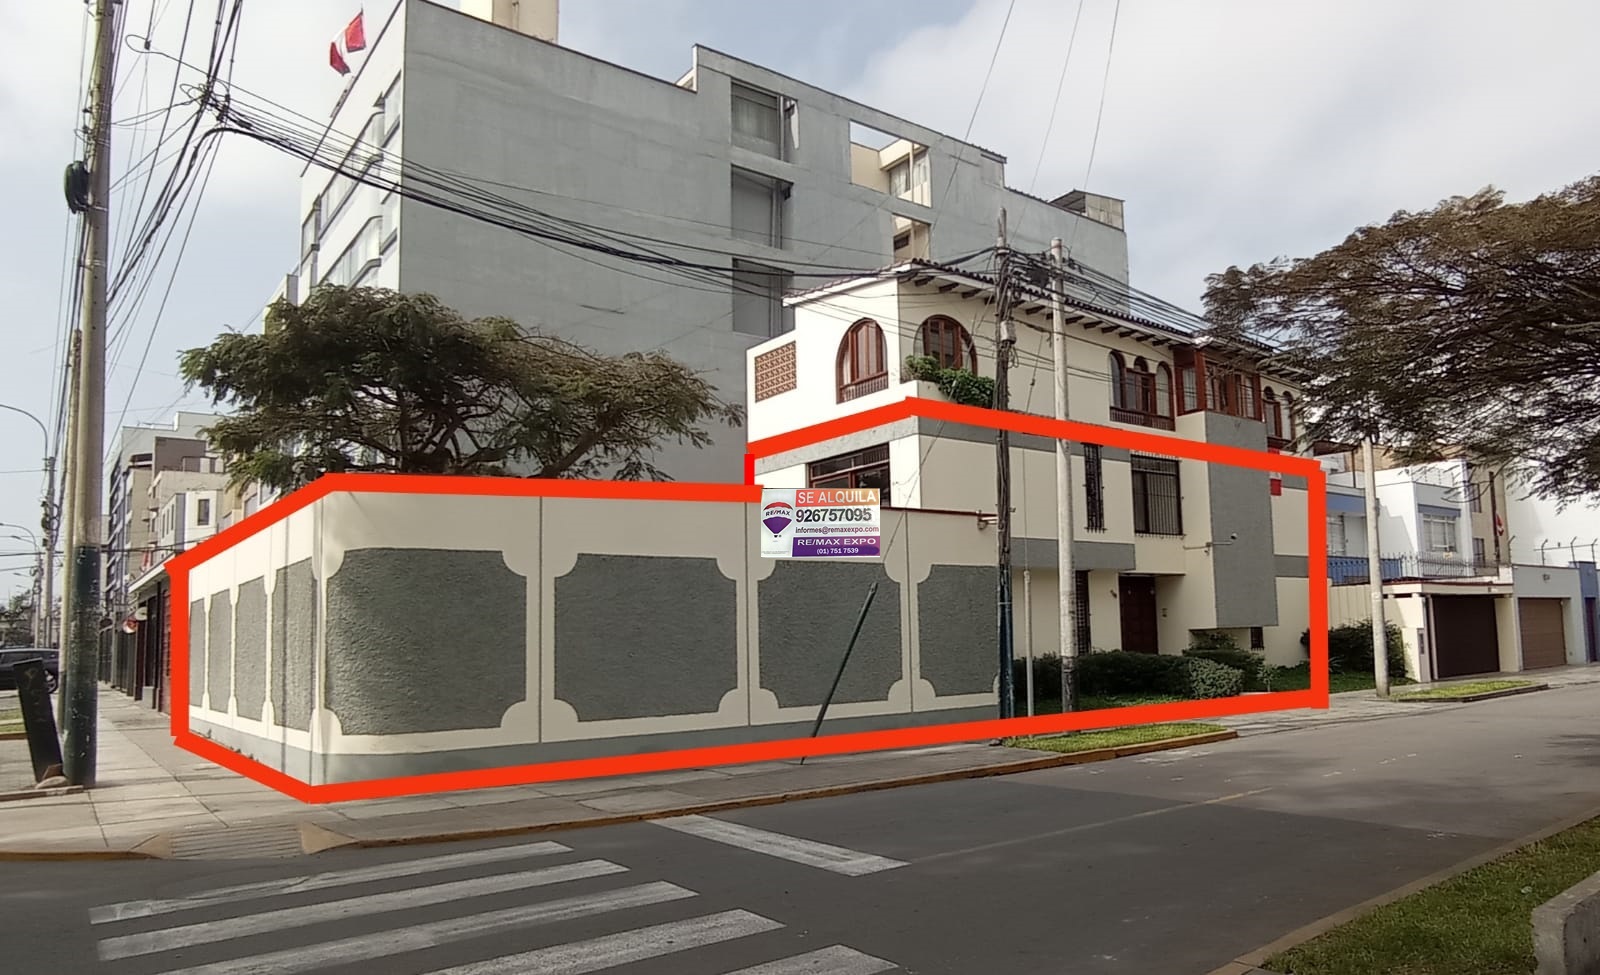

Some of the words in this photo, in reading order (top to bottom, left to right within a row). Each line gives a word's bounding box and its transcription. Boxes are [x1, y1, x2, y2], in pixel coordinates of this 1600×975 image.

[798, 492, 814, 504] SE
[818, 490, 876, 503] ALQUILA
[796, 508, 872, 522] 926757095
[796, 526, 879, 534] informes@remaxexpo.com
